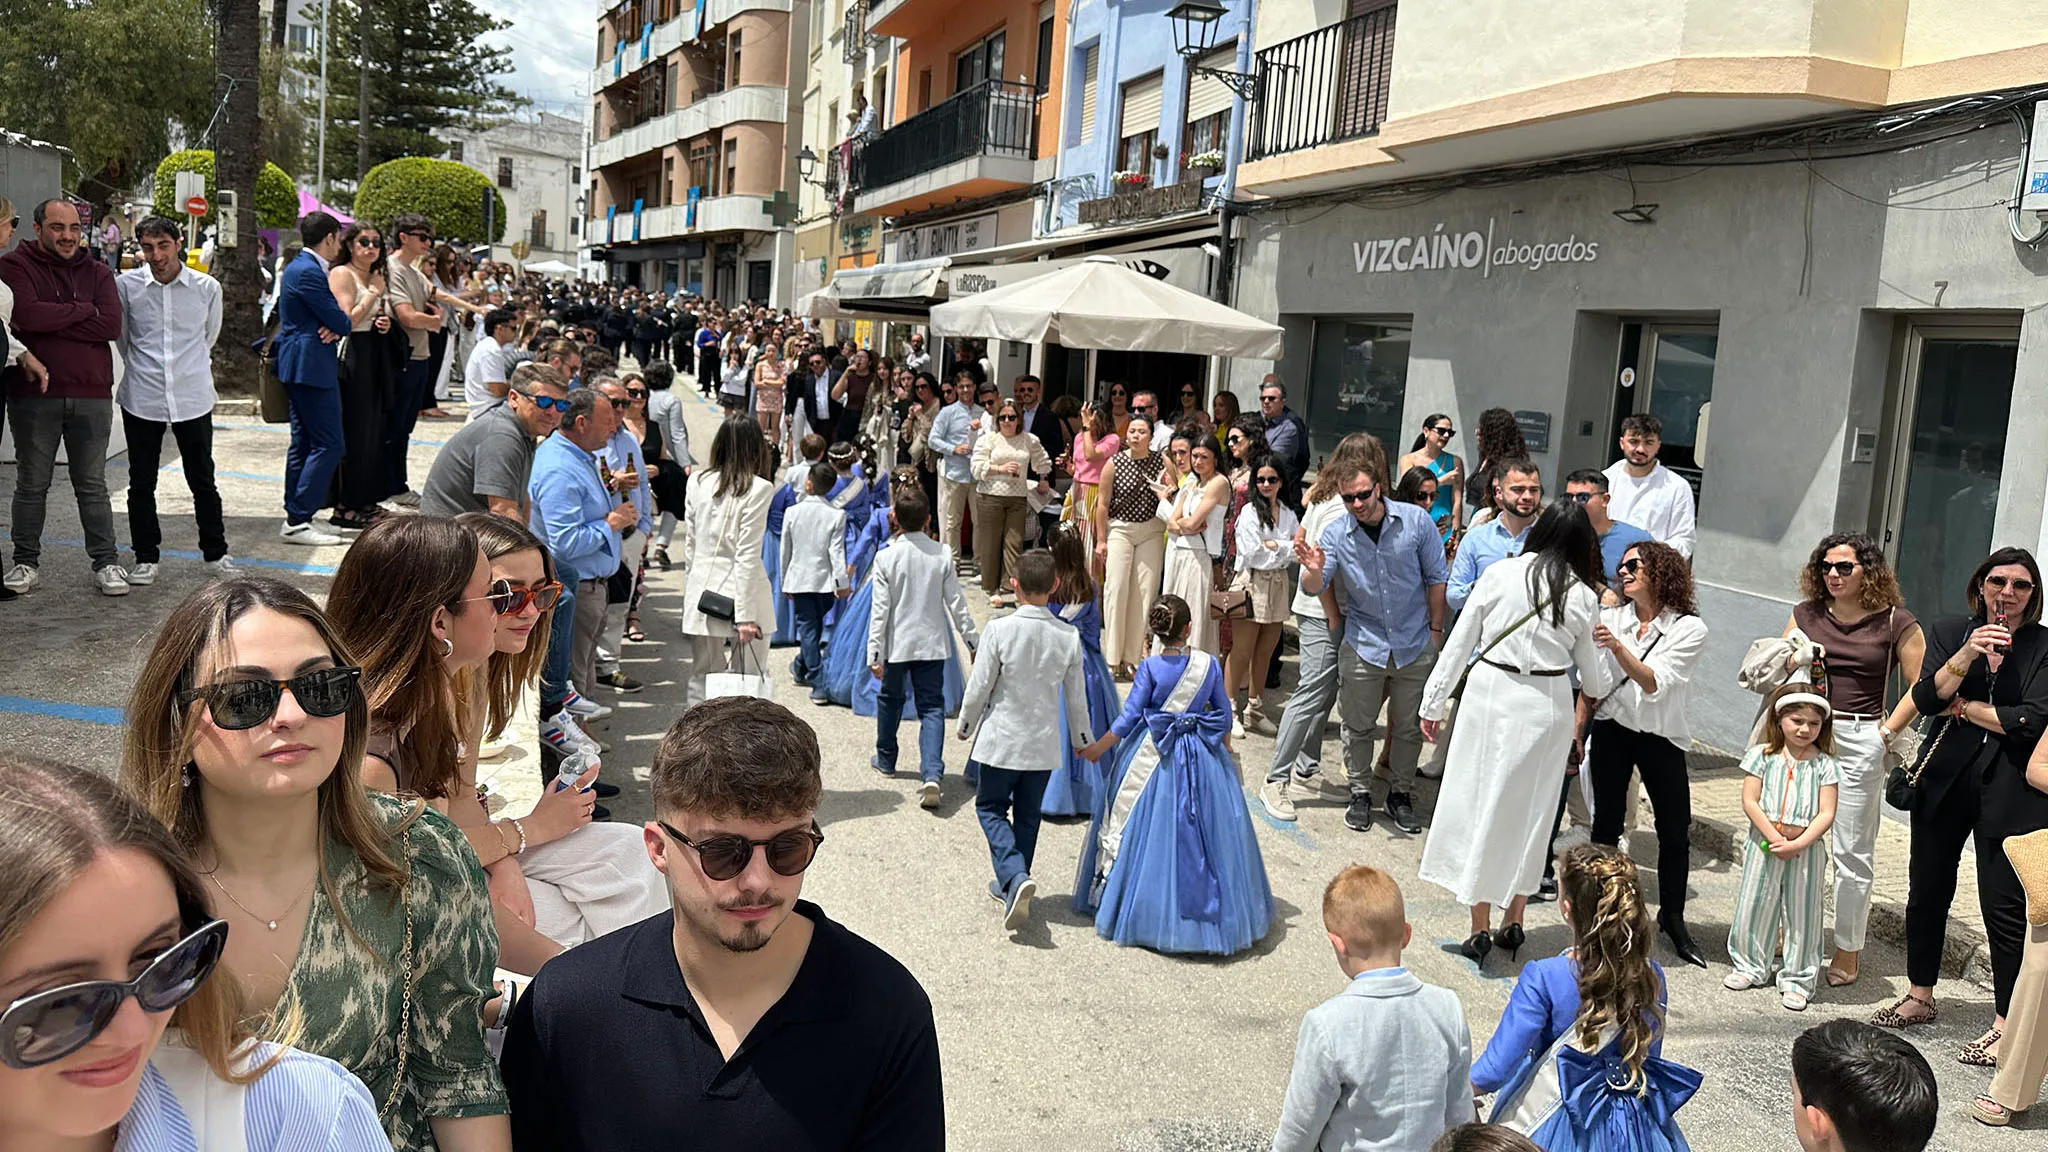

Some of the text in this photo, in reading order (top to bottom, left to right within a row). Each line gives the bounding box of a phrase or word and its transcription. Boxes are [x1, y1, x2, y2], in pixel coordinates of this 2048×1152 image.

[1353, 223, 1598, 273] VIZCAÍNO abogados
[1934, 281, 1948, 307] 7
